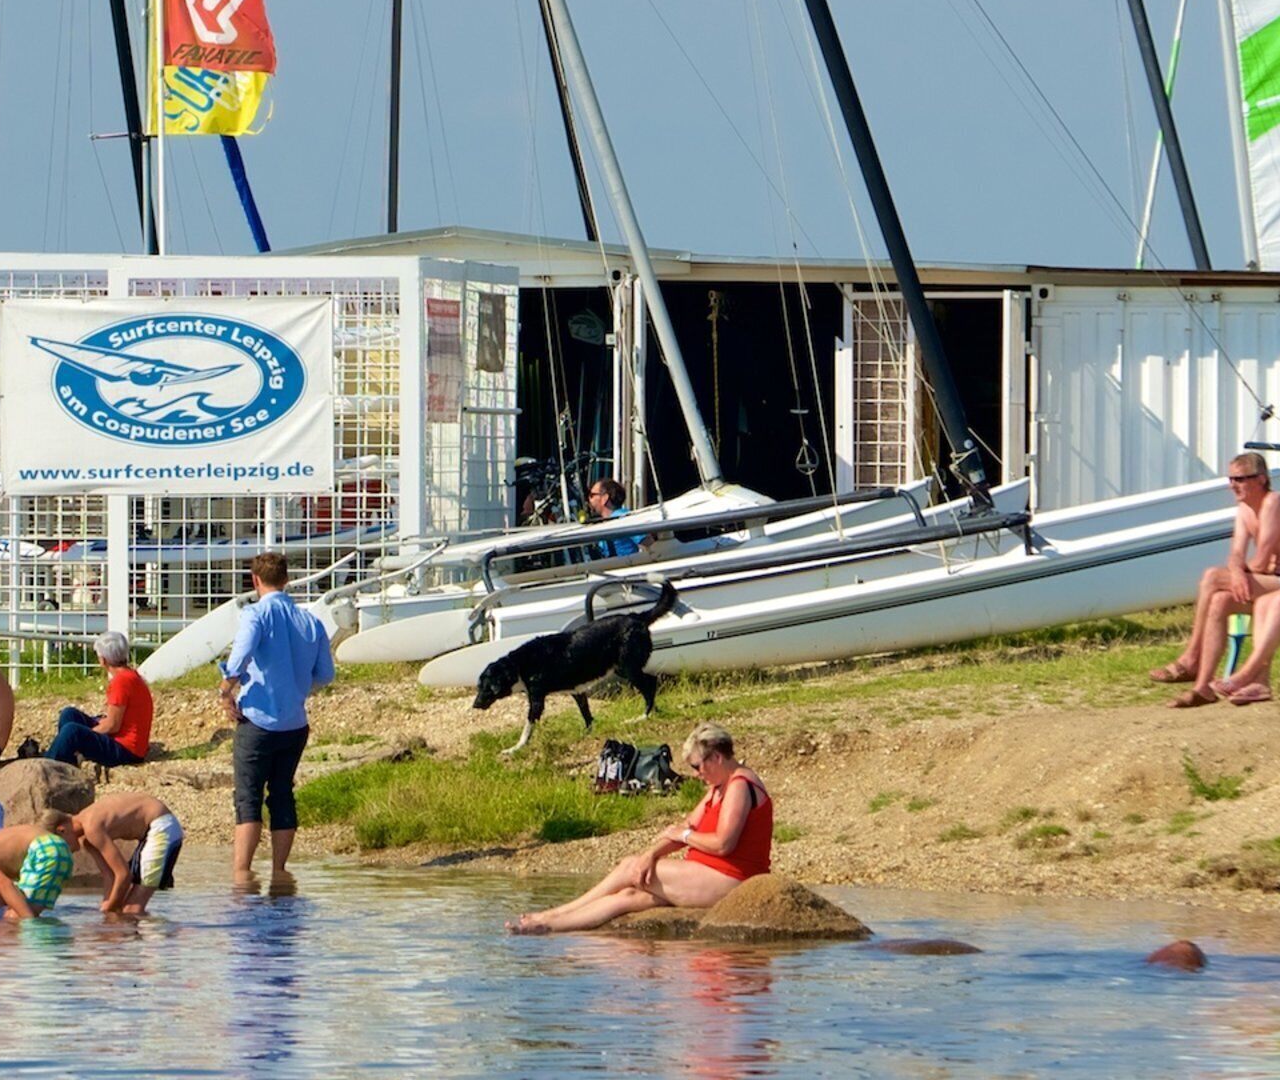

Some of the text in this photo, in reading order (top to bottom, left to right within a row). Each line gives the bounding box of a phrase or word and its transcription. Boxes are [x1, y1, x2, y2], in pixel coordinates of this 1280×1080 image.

[172, 44, 263, 65] FANATIC
[108, 319, 286, 389] Surfcenter Leipzig
[59, 385, 270, 440] am Cospudener See
[19, 462, 314, 481] www.surfcenterleipzig.de
